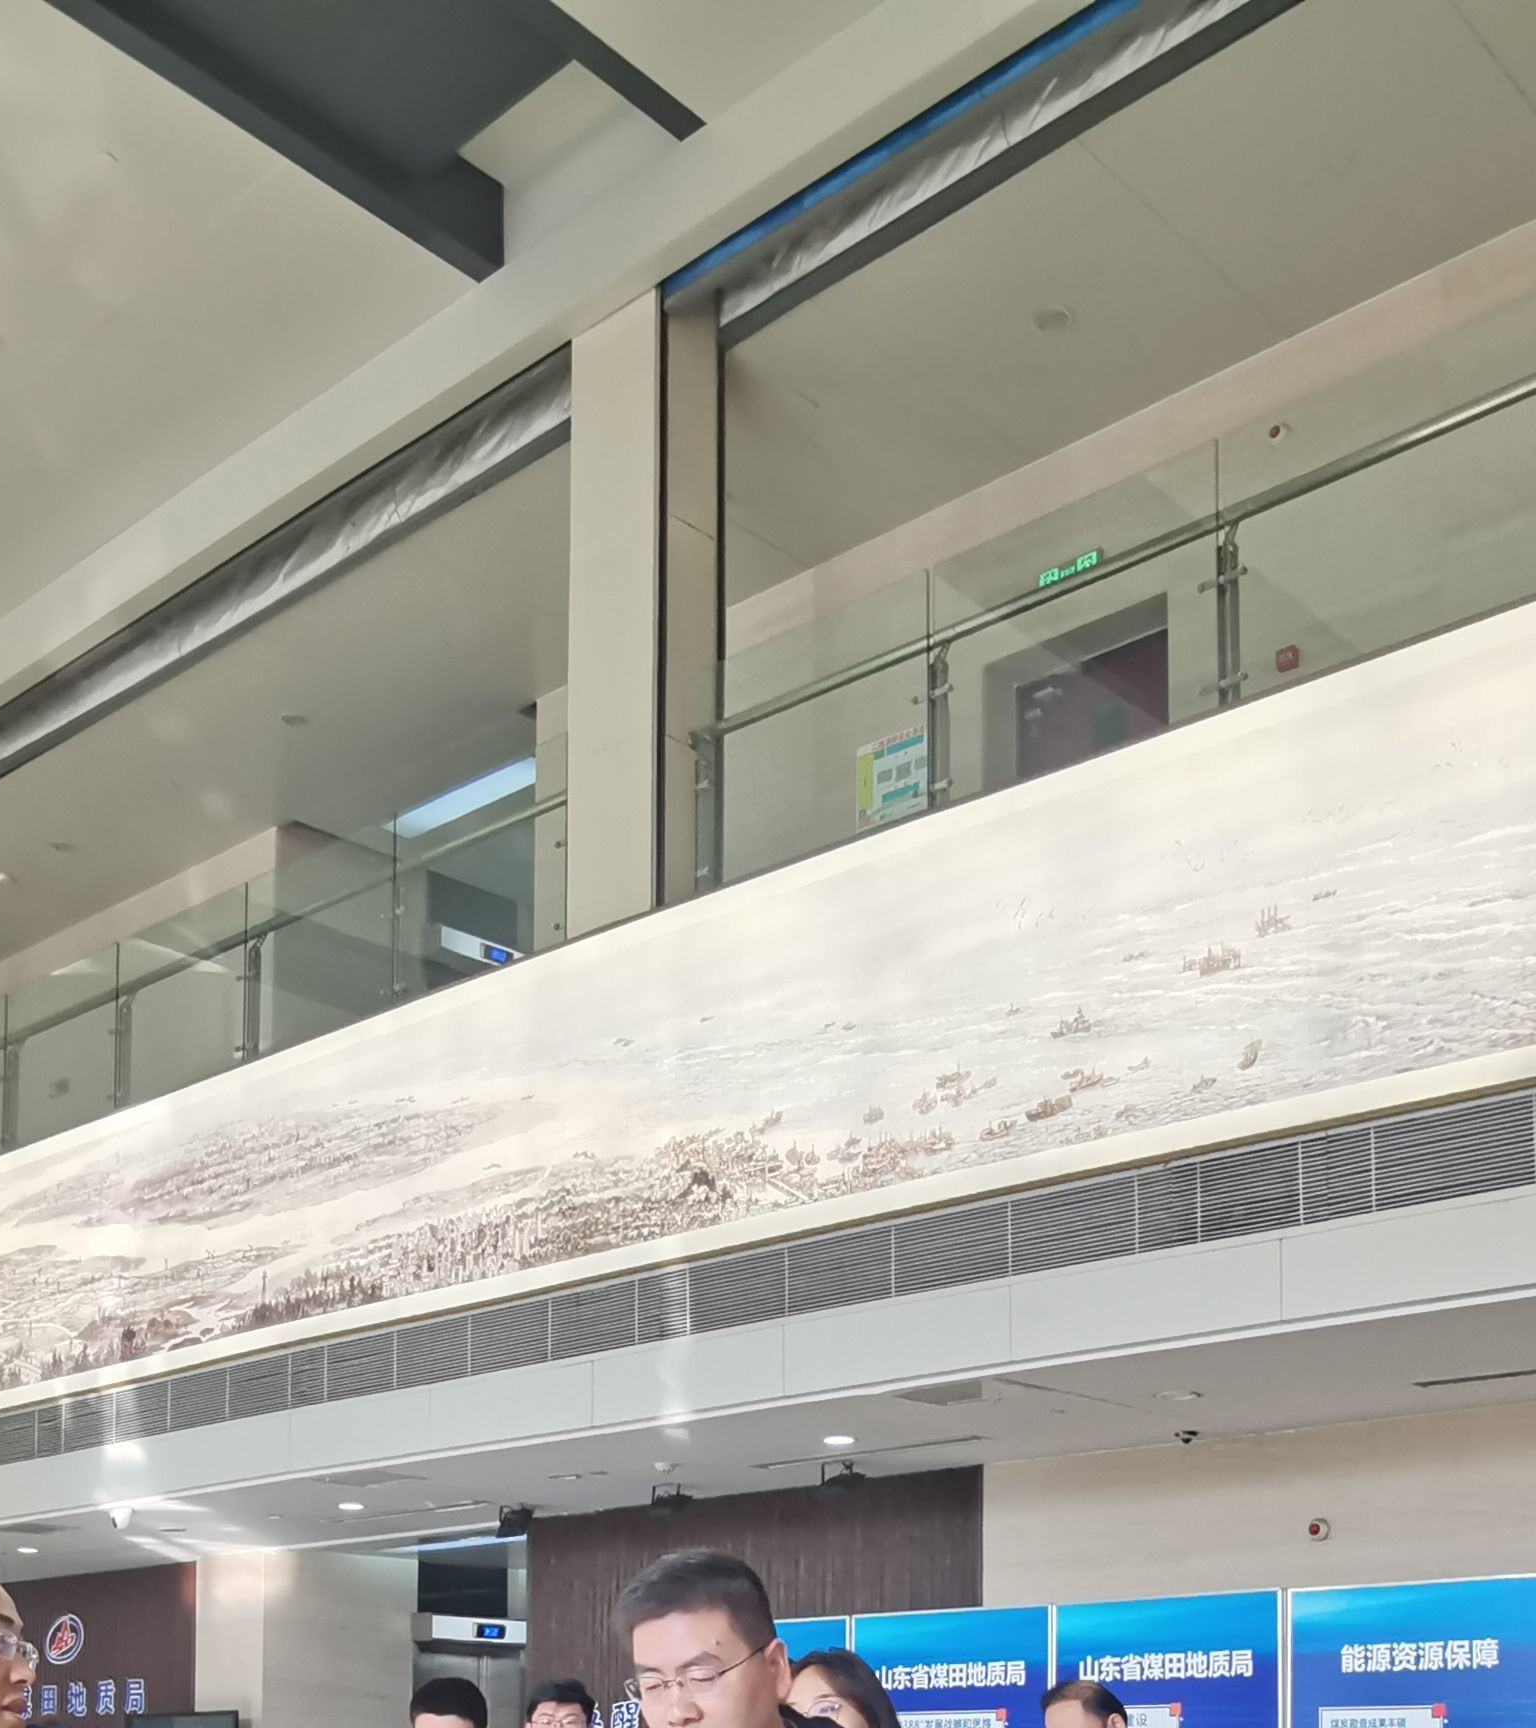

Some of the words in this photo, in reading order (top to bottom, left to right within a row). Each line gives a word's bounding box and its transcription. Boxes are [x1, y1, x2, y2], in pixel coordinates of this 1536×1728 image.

[1079, 1650, 1254, 1683] 山东省煤田地质局
[1341, 1638, 1500, 1673] 能源资源保障
[875, 1660, 1026, 1690] 山东省煤田地质局
